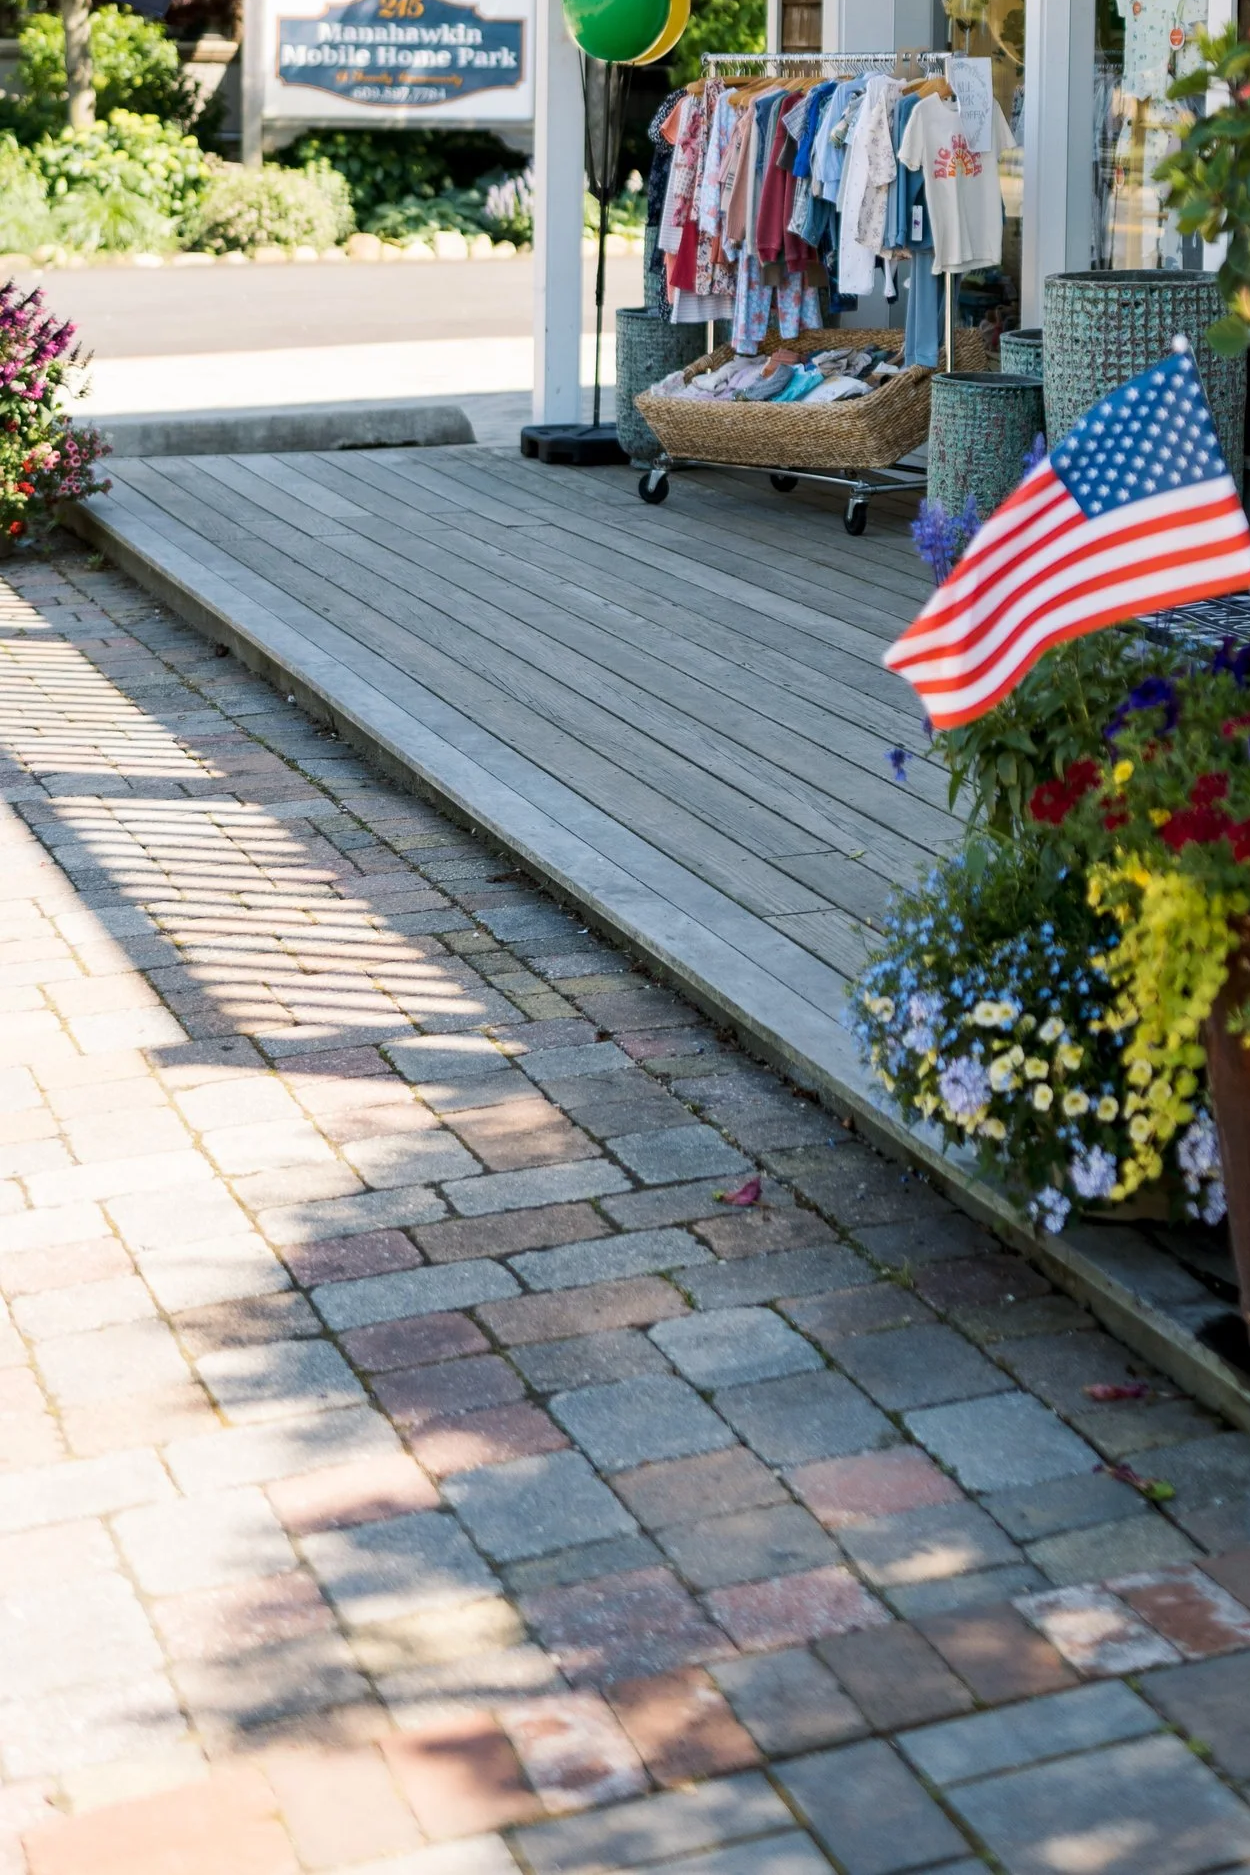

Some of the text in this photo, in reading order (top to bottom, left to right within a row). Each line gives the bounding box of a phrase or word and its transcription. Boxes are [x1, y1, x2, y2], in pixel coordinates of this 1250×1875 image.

[317, 23, 483, 45] Manahawkin
[280, 44, 518, 68] Mobile Home Park
